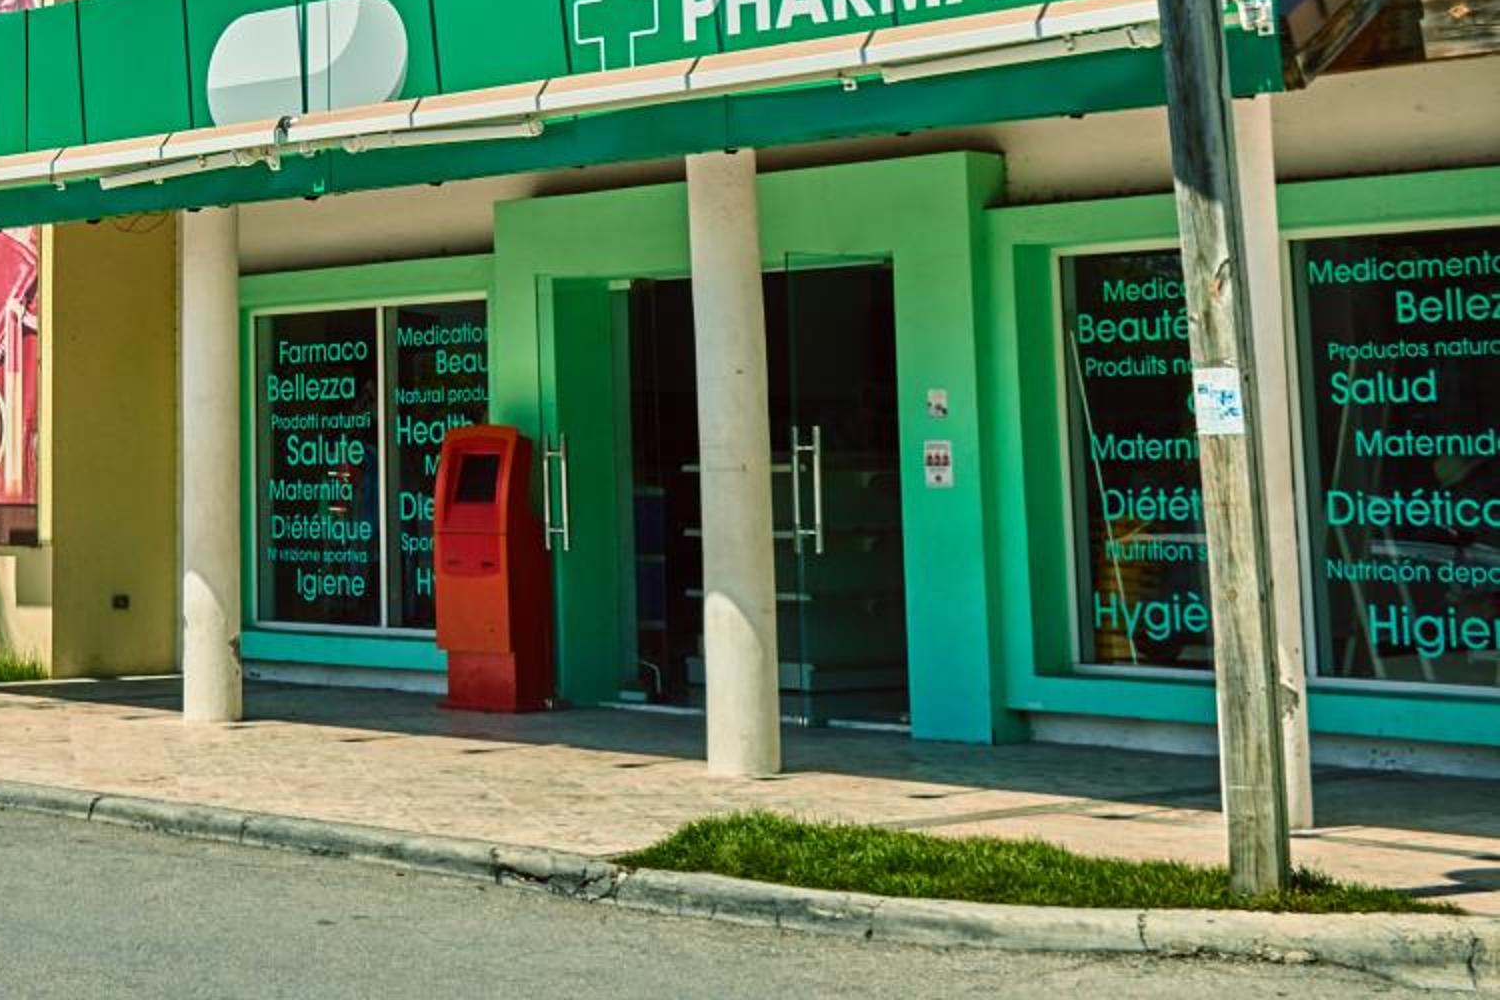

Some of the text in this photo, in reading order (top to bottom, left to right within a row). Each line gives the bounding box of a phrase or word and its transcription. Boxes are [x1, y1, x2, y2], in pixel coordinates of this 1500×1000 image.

[1077, 307, 1189, 343] Beauté
[279, 340, 368, 364] Farmaco
[1327, 338, 1429, 360] Productos
[1085, 355, 1168, 377] Produits
[266, 373, 356, 402] Bellezza
[394, 385, 445, 405] Natural
[1330, 368, 1437, 406] Salud
[271, 411, 371, 431] Prodotti naturali
[286, 433, 365, 466] Salute
[1354, 428, 1500, 457] Maternid
[270, 513, 372, 545] Diététique
[1104, 541, 1192, 562] Nutrition
[297, 567, 366, 602] Igiene
[1326, 559, 1432, 583] Nutrición
[1093, 591, 1209, 641] Hygiè
